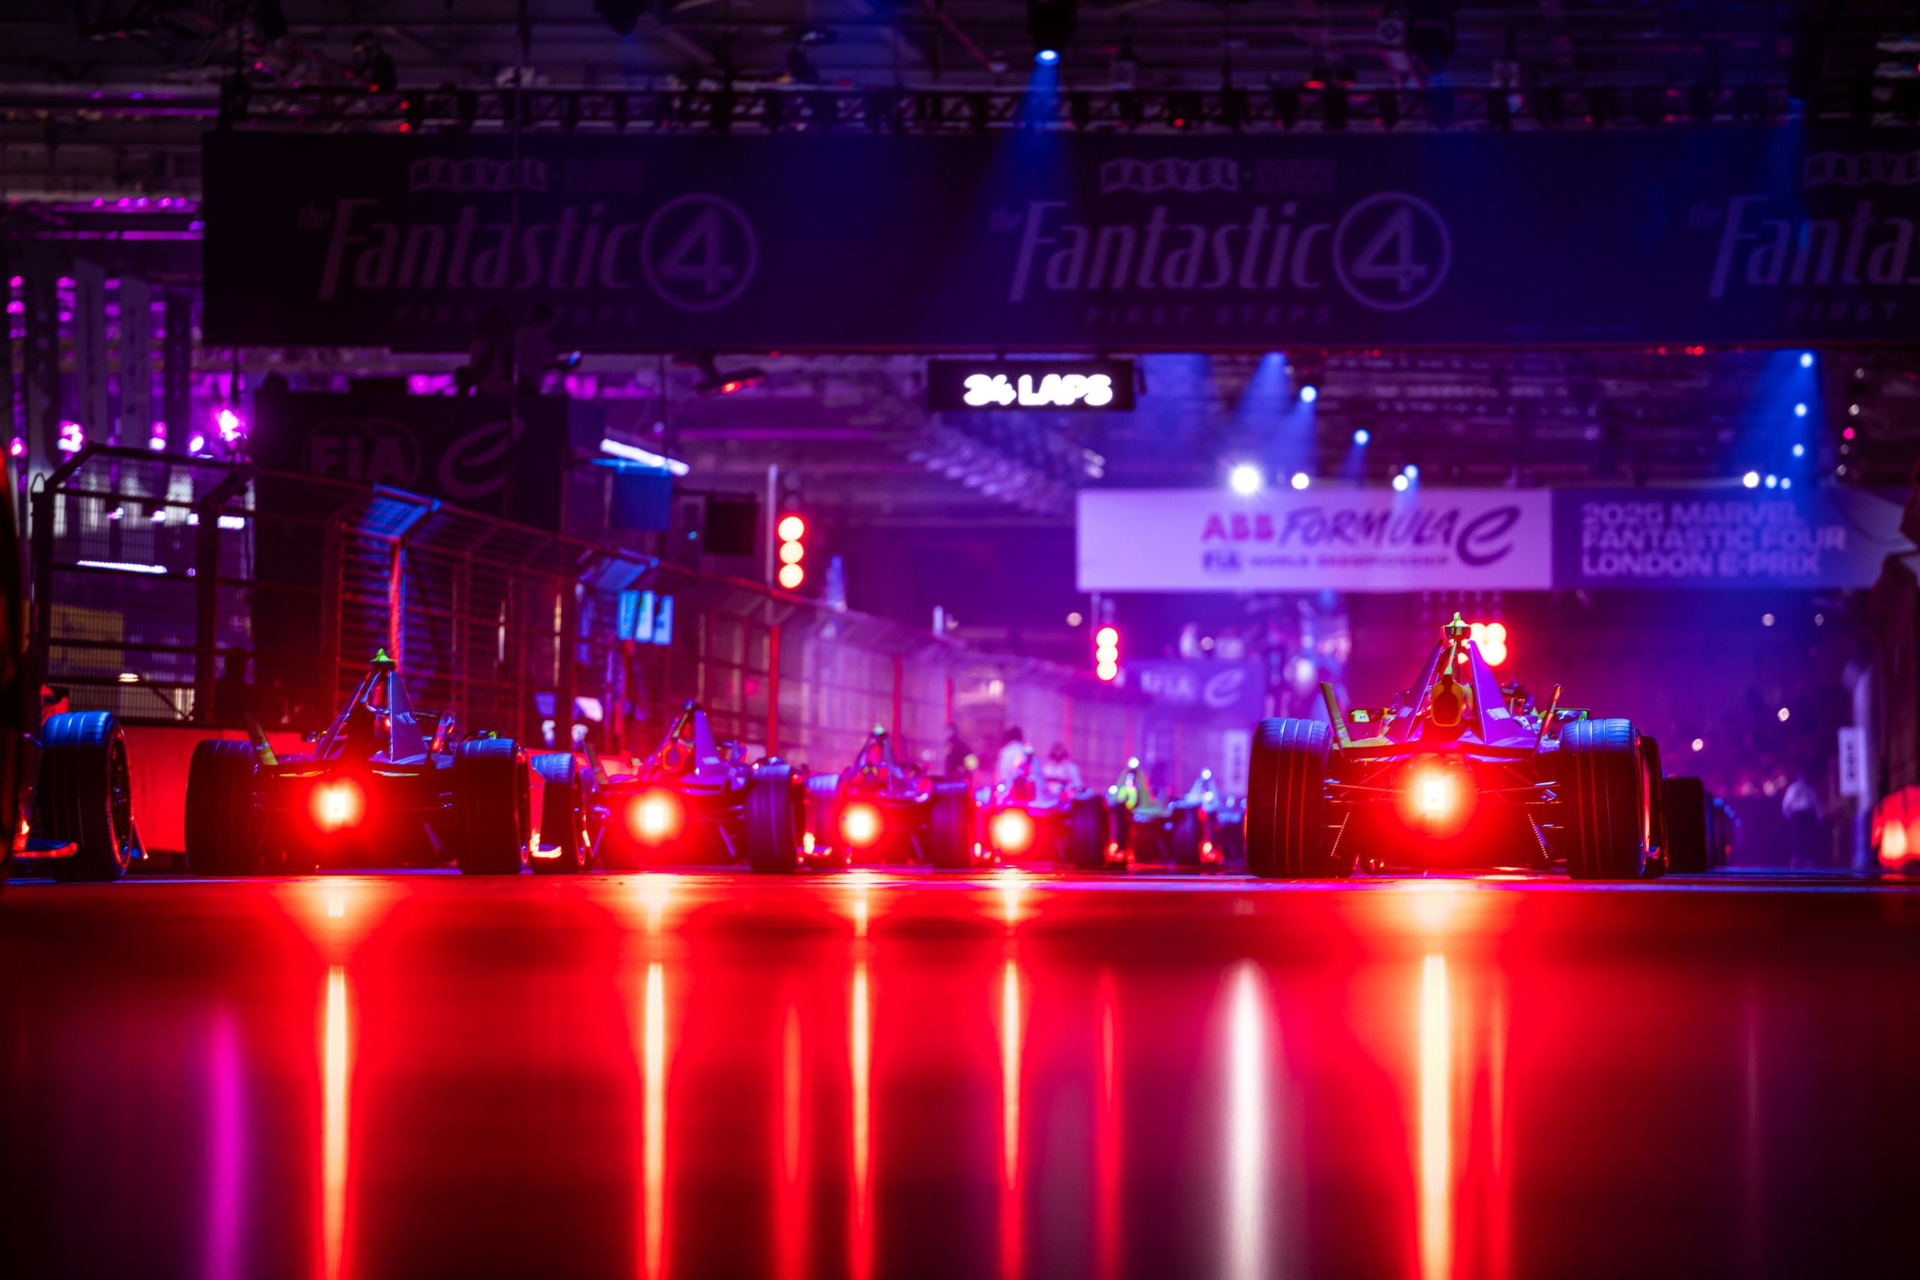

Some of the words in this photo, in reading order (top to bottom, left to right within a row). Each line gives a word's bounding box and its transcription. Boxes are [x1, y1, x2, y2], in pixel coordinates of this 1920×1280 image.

[1099, 157, 1239, 194] MARVEL
[1802, 151, 1920, 188] MARVE
[317, 199, 642, 300] Fantastic
[1009, 201, 1331, 301] Fantastic
[1707, 195, 1920, 299] Fanta
[1018, 373, 1114, 406] LAPS
[1201, 512, 1275, 542] ABB
[1279, 506, 1461, 547] FORMULA
[1671, 502, 1805, 526] MARVEL
[1582, 526, 1756, 550] FANTASTIC
[1761, 526, 1846, 550] FOUR
[1582, 551, 1712, 577] LONDON
[1718, 551, 1820, 577] E-PRIX
